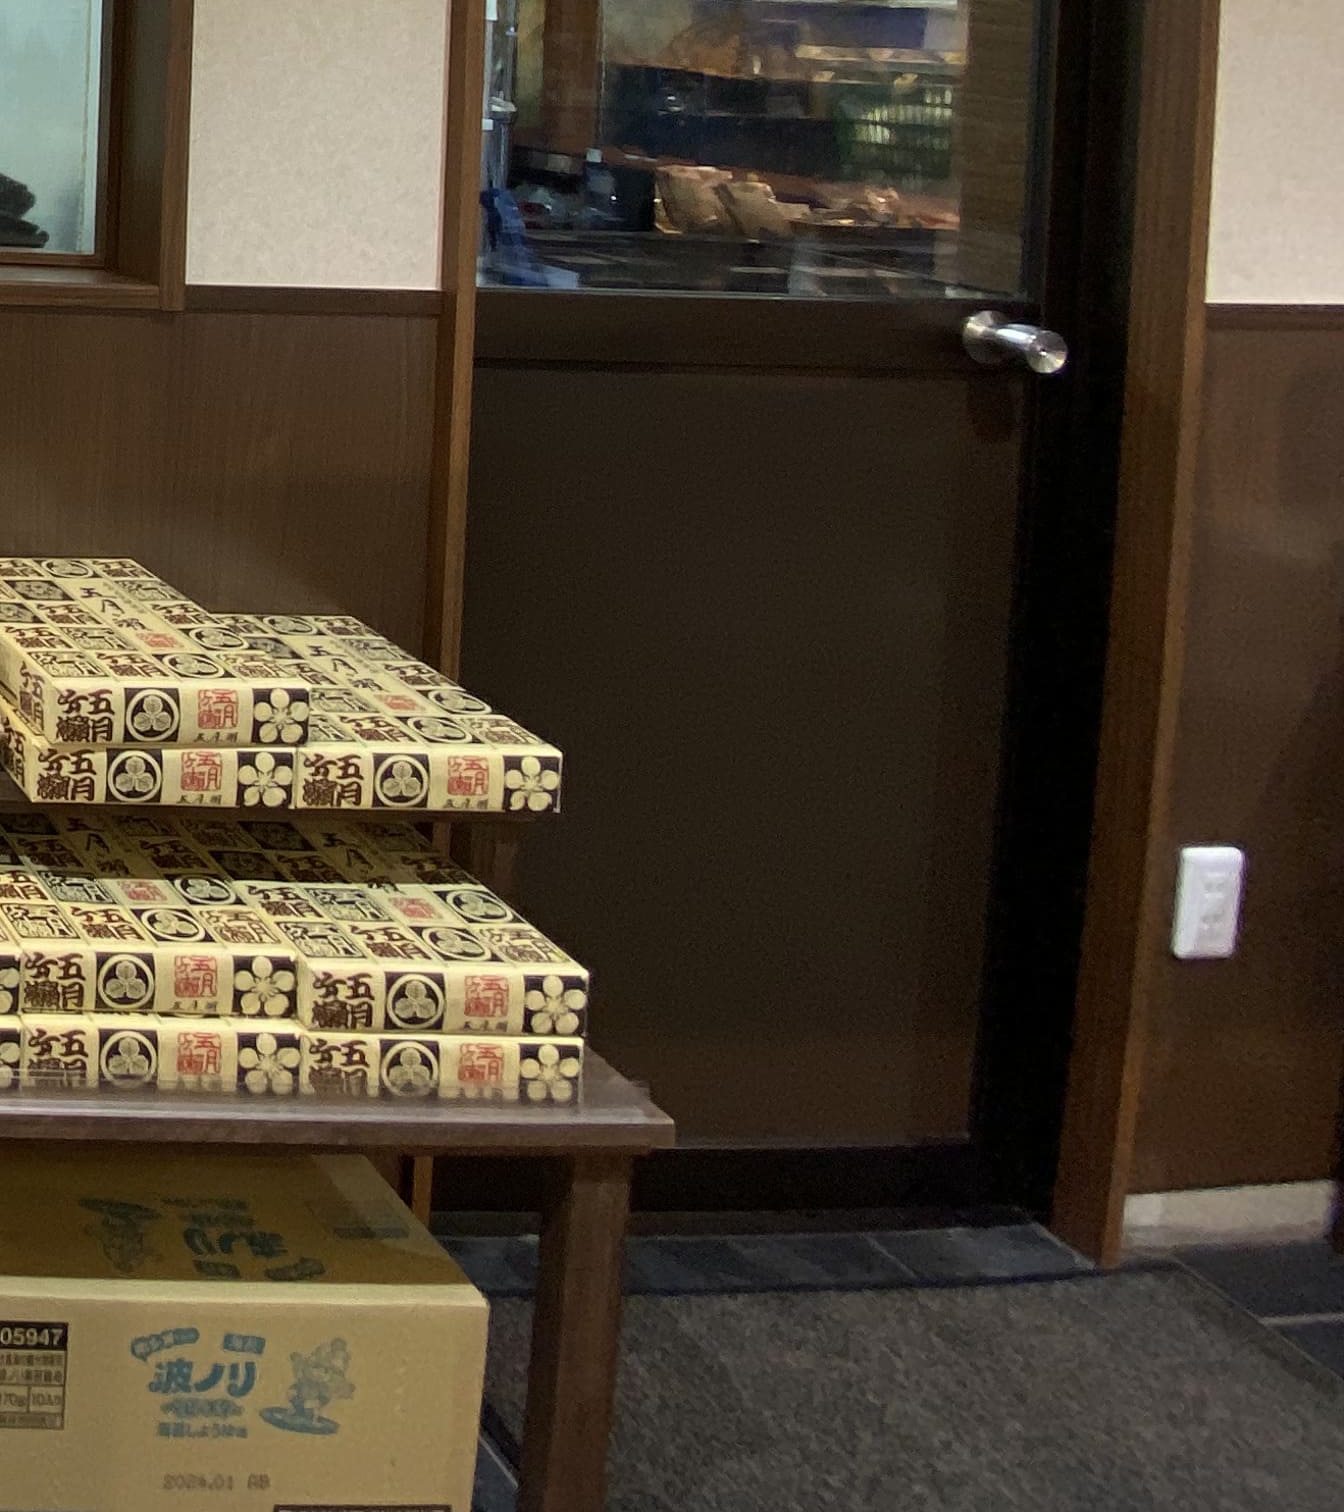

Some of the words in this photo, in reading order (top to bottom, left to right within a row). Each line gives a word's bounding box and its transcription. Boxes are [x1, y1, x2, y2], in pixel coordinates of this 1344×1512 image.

[0, 1327, 63, 1346] 05947
[147, 1357, 257, 1398] 波ノリ
